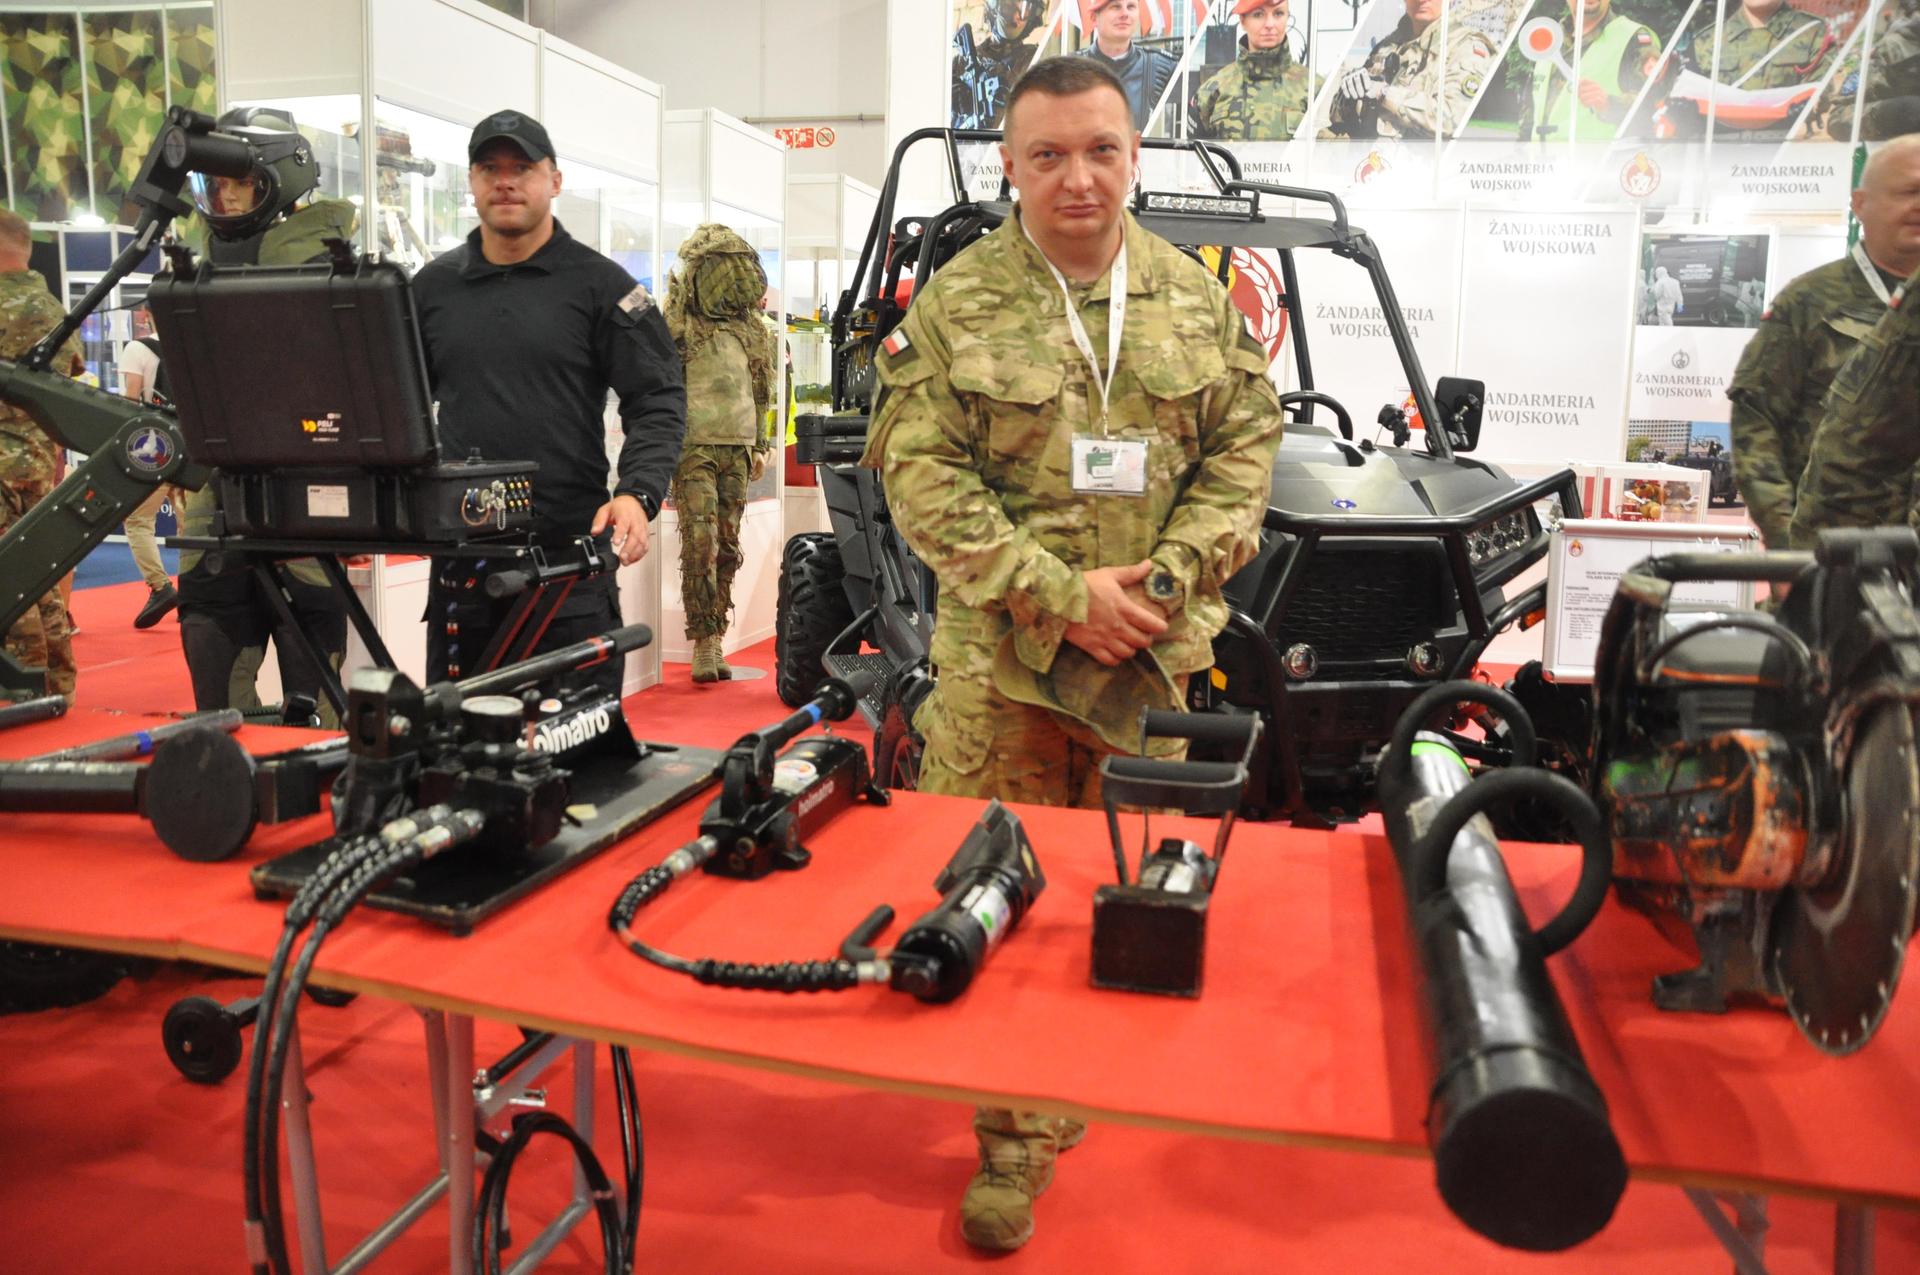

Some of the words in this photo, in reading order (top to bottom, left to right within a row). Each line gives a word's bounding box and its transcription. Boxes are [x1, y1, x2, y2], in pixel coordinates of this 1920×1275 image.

[1460, 160, 1555, 174] ŻANDARMERIA
[1731, 164, 1835, 177] ŻANDARMERIA
[1470, 179, 1533, 192] WOJSKOW
[1742, 182, 1821, 195] WOJSKOWA
[1488, 218, 1613, 237] ŻANDARMERIA
[1502, 240, 1597, 255] WOJSKOWA
[1316, 302, 1435, 321] ŻANDARERIA
[1329, 323, 1420, 339] WOJSKOA
[1635, 371, 1725, 386] ŻANDARMERIA
[1645, 386, 1713, 398] WOJSKOWA
[1484, 392, 1596, 409] ANDARMERIA
[1488, 409, 1580, 426] WOJSKOWA
